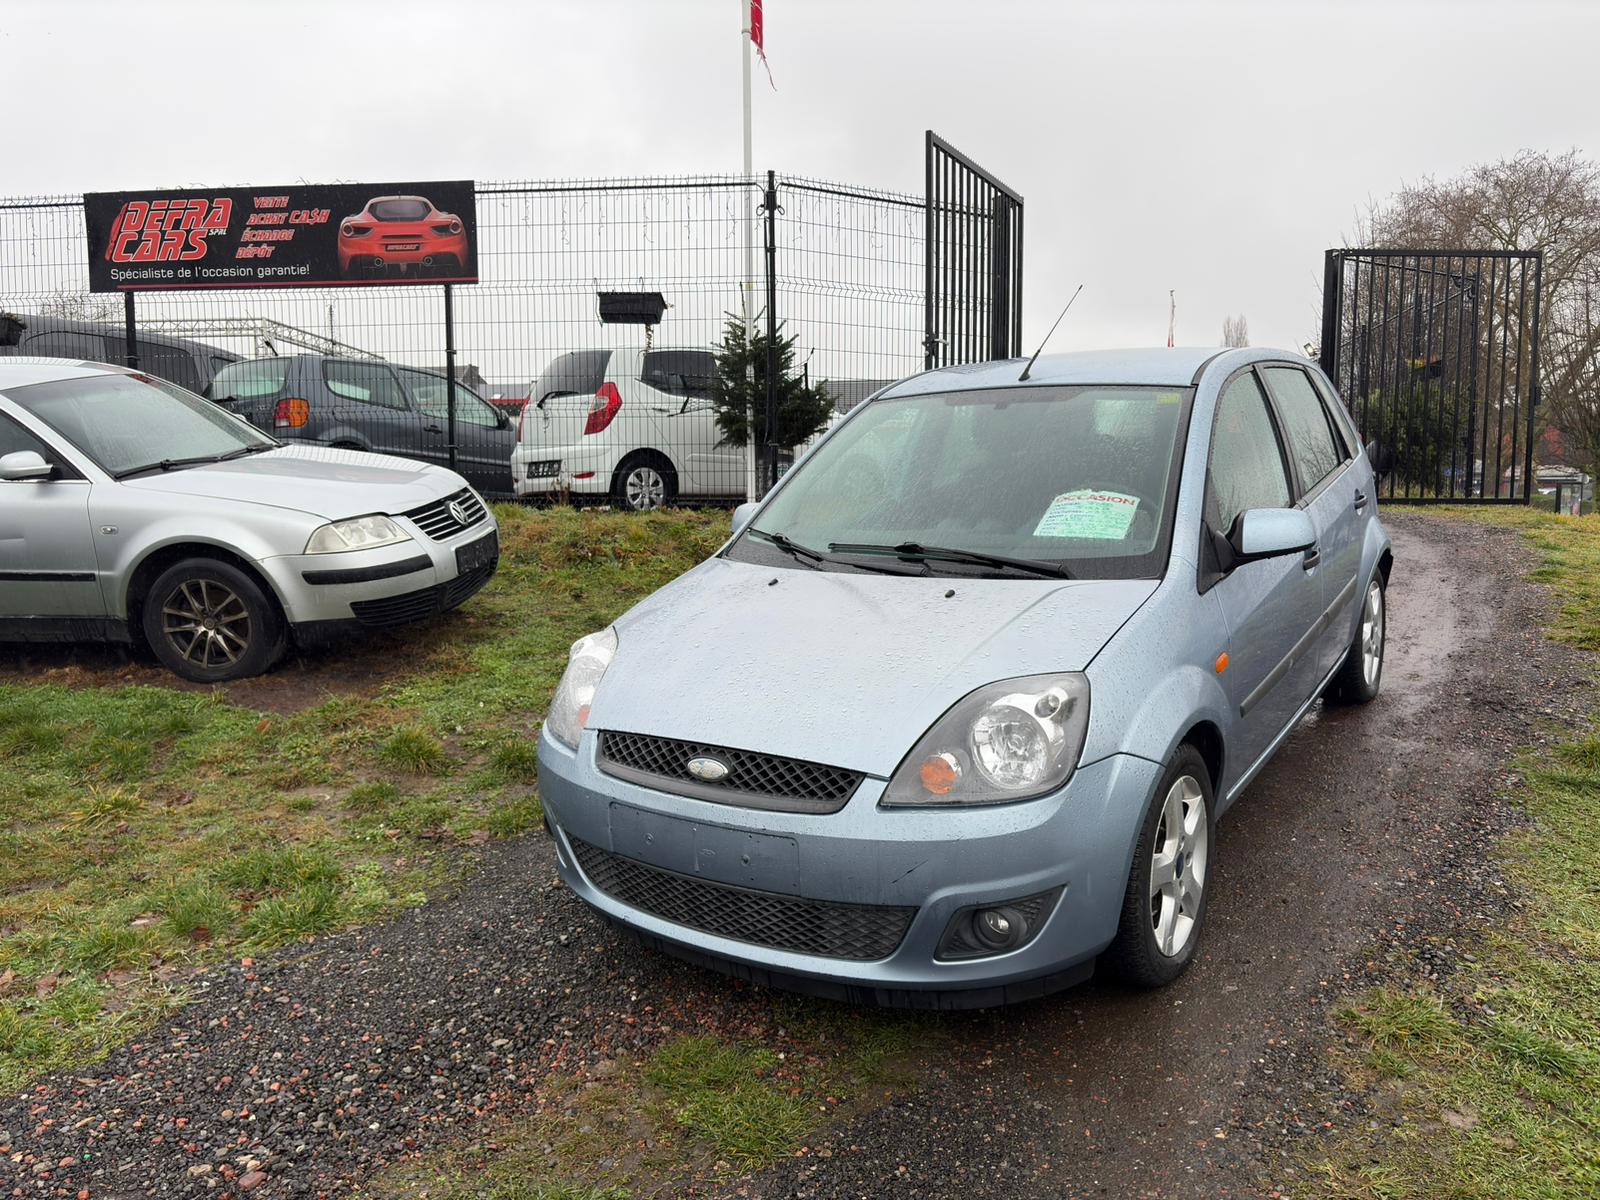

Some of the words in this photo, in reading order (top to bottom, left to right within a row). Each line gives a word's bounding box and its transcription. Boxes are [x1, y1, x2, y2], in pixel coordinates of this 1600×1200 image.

[254, 196, 289, 208] VENTE
[121, 198, 232, 231] DEFRA
[246, 213, 288, 225] ACHAT
[289, 208, 331, 225] CA$H
[241, 227, 295, 241] ÉCHANGE
[112, 229, 208, 262] CARS
[208, 228, 227, 236] SPRL
[235, 243, 275, 258] DÉPÔT
[110, 267, 174, 281] Spécialiste
[177, 267, 192, 278] de
[195, 264, 254, 278] l'occasion
[257, 264, 310, 278] garantie!
[1056, 495, 1136, 506] OCCASION
